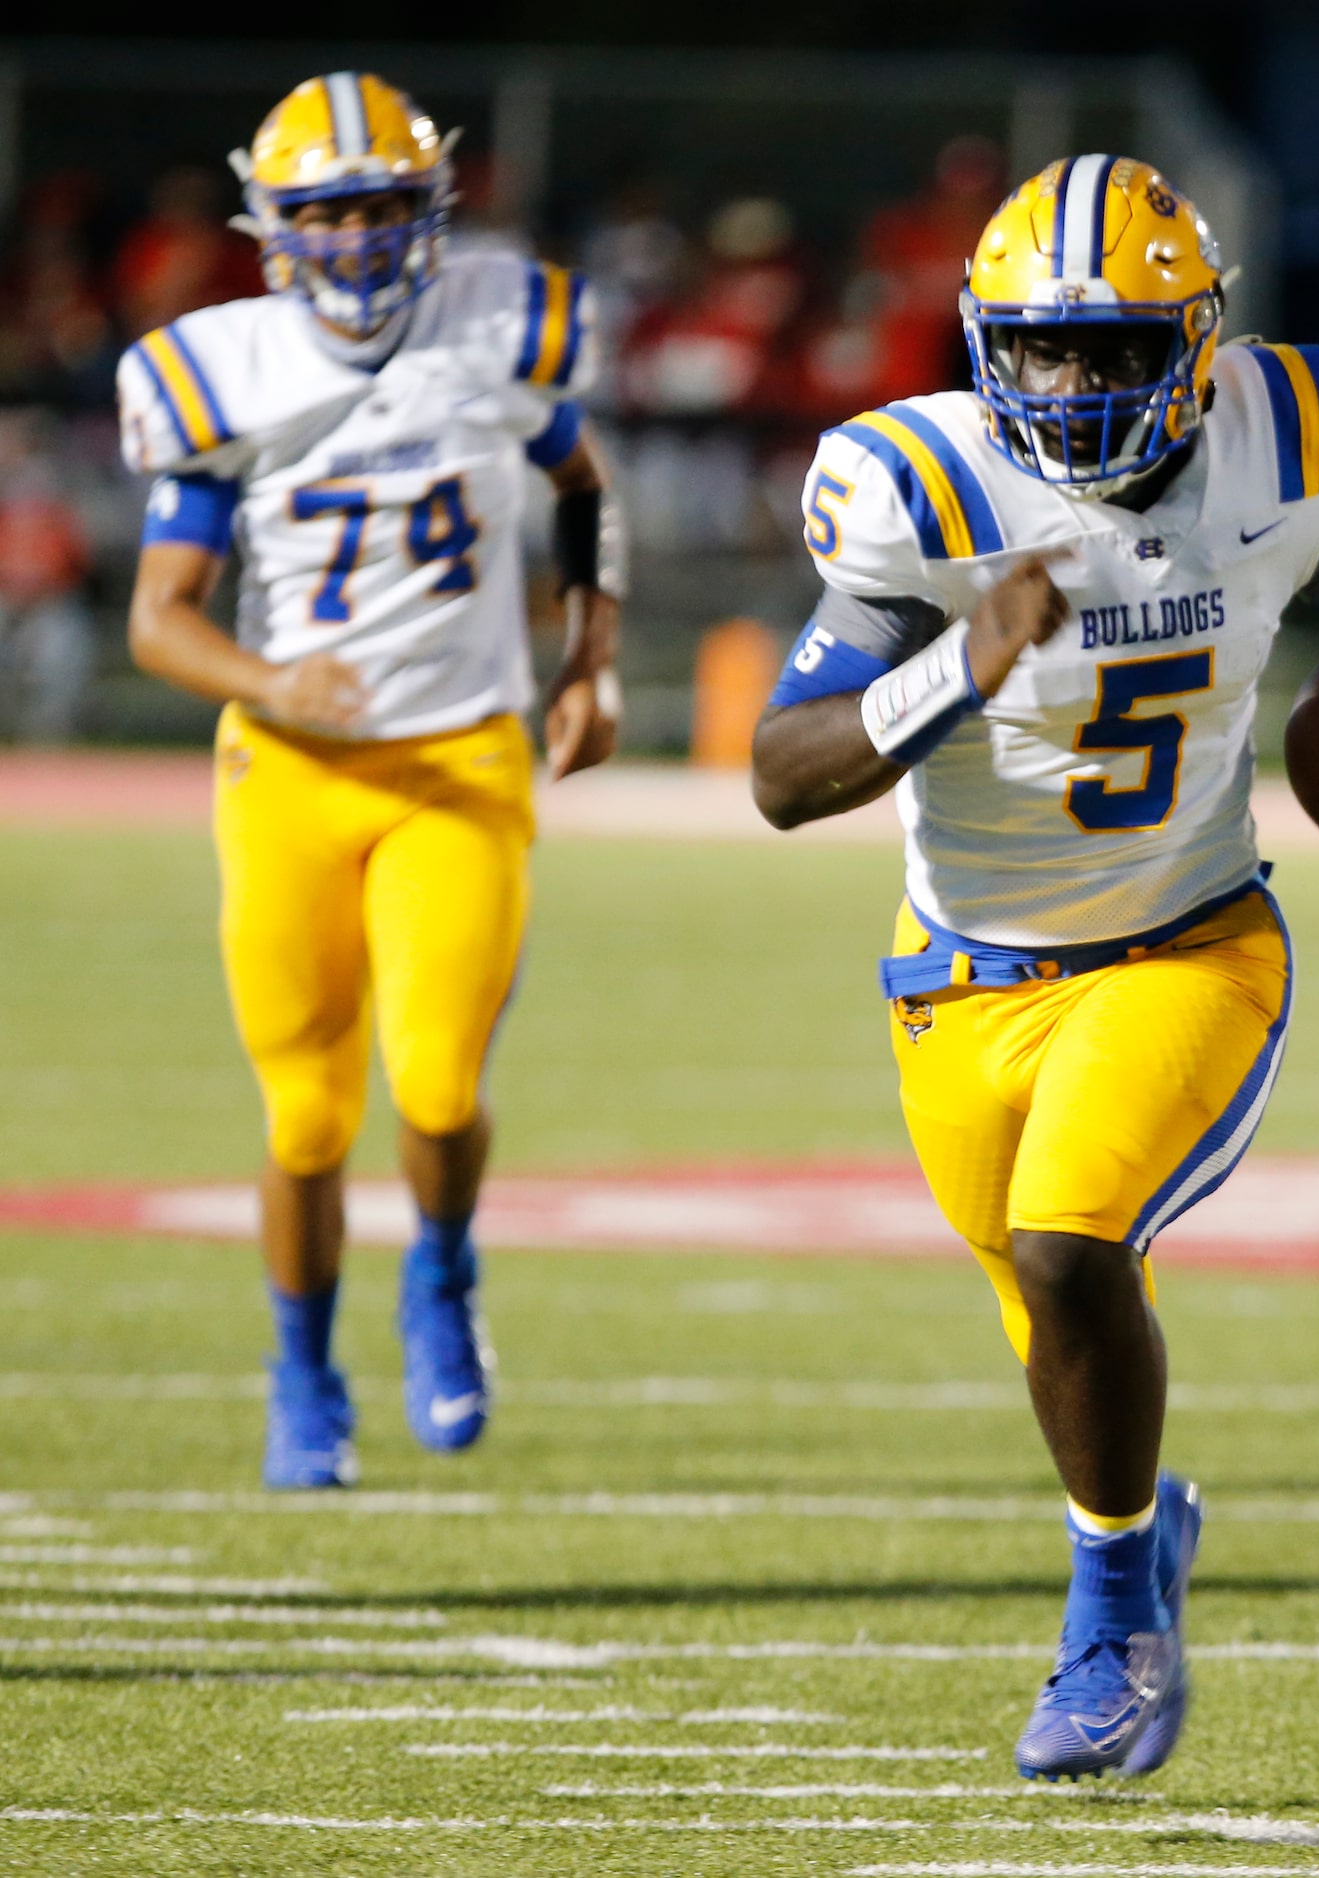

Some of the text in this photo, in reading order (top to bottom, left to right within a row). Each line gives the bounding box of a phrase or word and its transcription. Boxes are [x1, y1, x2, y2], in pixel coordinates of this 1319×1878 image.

[286, 472, 481, 627] 74
[806, 464, 856, 562] 5
[794, 626, 835, 674] 5
[1080, 588, 1225, 650] BULLDOGS
[1063, 645, 1215, 834] 5
